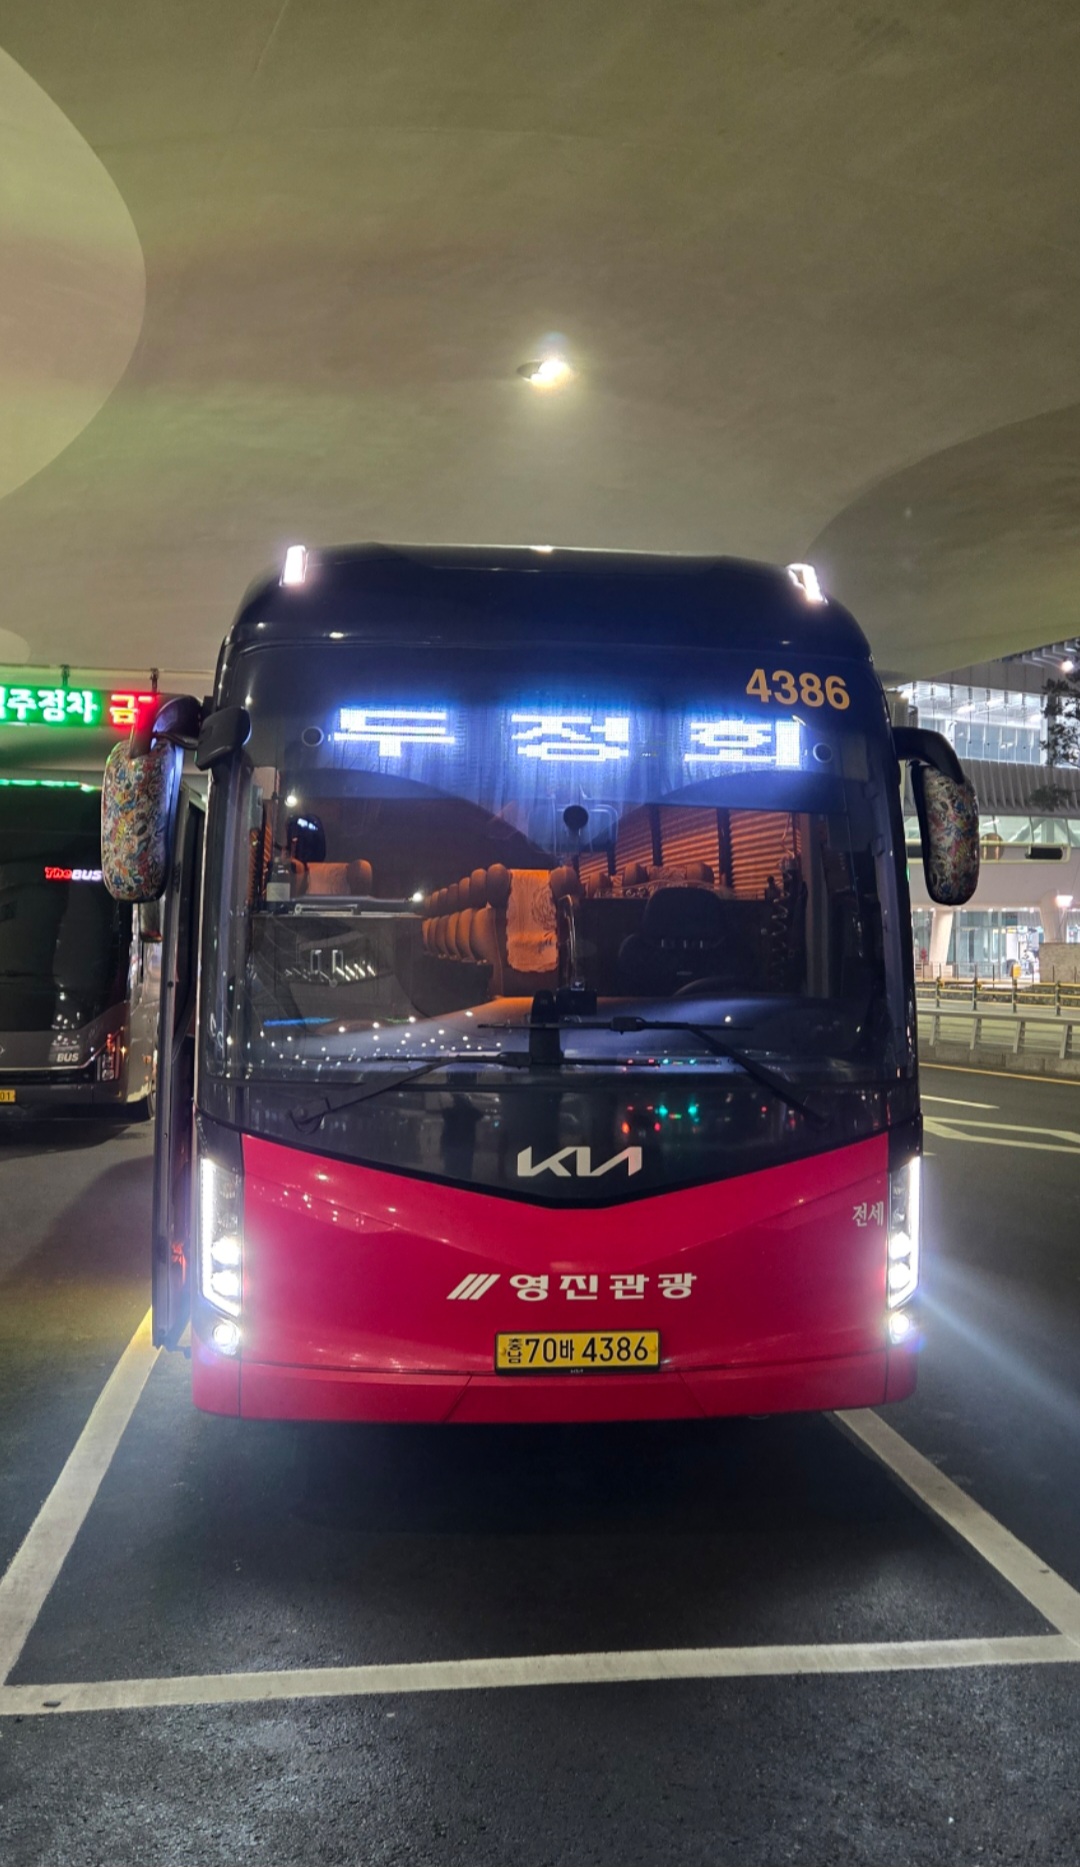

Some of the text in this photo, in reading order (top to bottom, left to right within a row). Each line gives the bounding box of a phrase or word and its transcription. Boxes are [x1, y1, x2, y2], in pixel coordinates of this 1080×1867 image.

[746, 668, 850, 710] 4386
[57, 1053, 79, 1063] BUS
[517, 1146, 643, 1177] KIA
[852, 1201, 884, 1227] 전세
[509, 1273, 697, 1301] 영진관광
